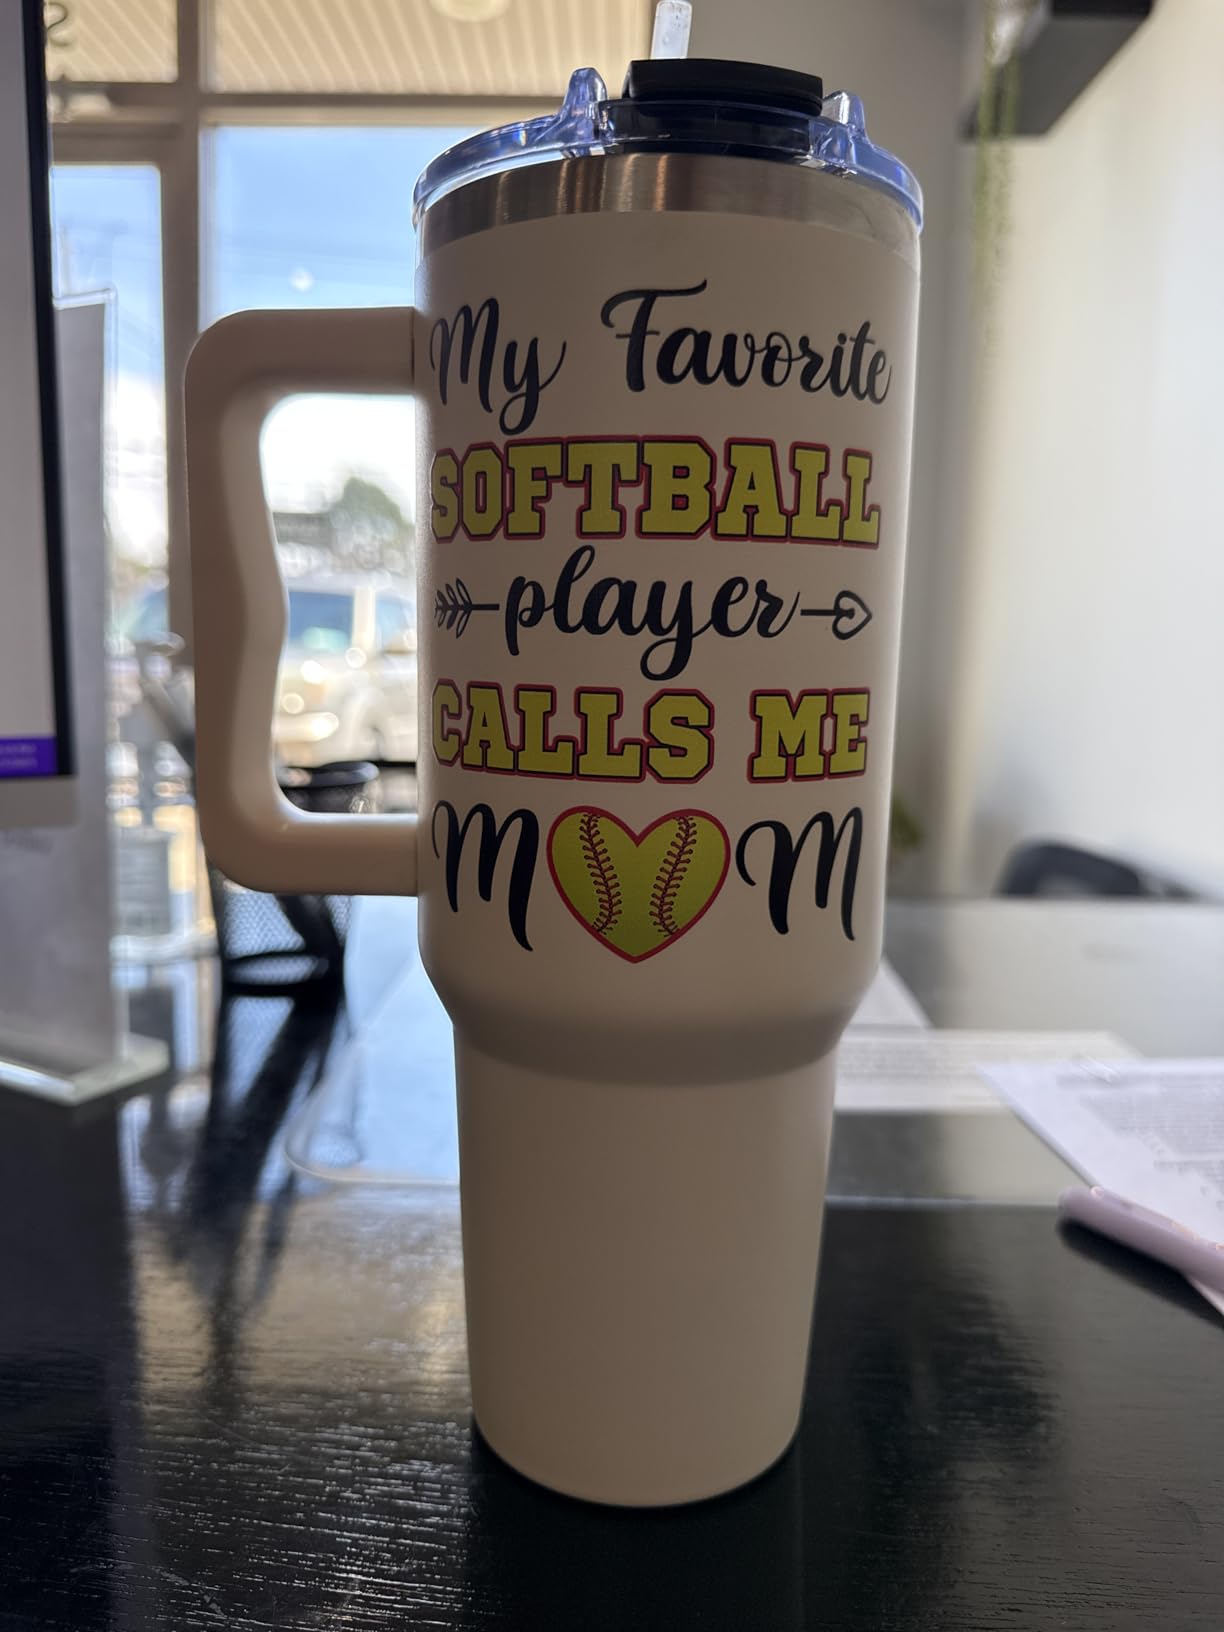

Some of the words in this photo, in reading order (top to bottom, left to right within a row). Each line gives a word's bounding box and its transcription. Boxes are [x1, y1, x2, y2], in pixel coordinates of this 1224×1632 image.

[430, 298, 567, 436] My
[600, 279, 892, 404] Favorite
[431, 435, 881, 549] SOFTBALL
[504, 545, 800, 681] player
[431, 678, 715, 784] CALLS
[748, 687, 871, 784] ME
